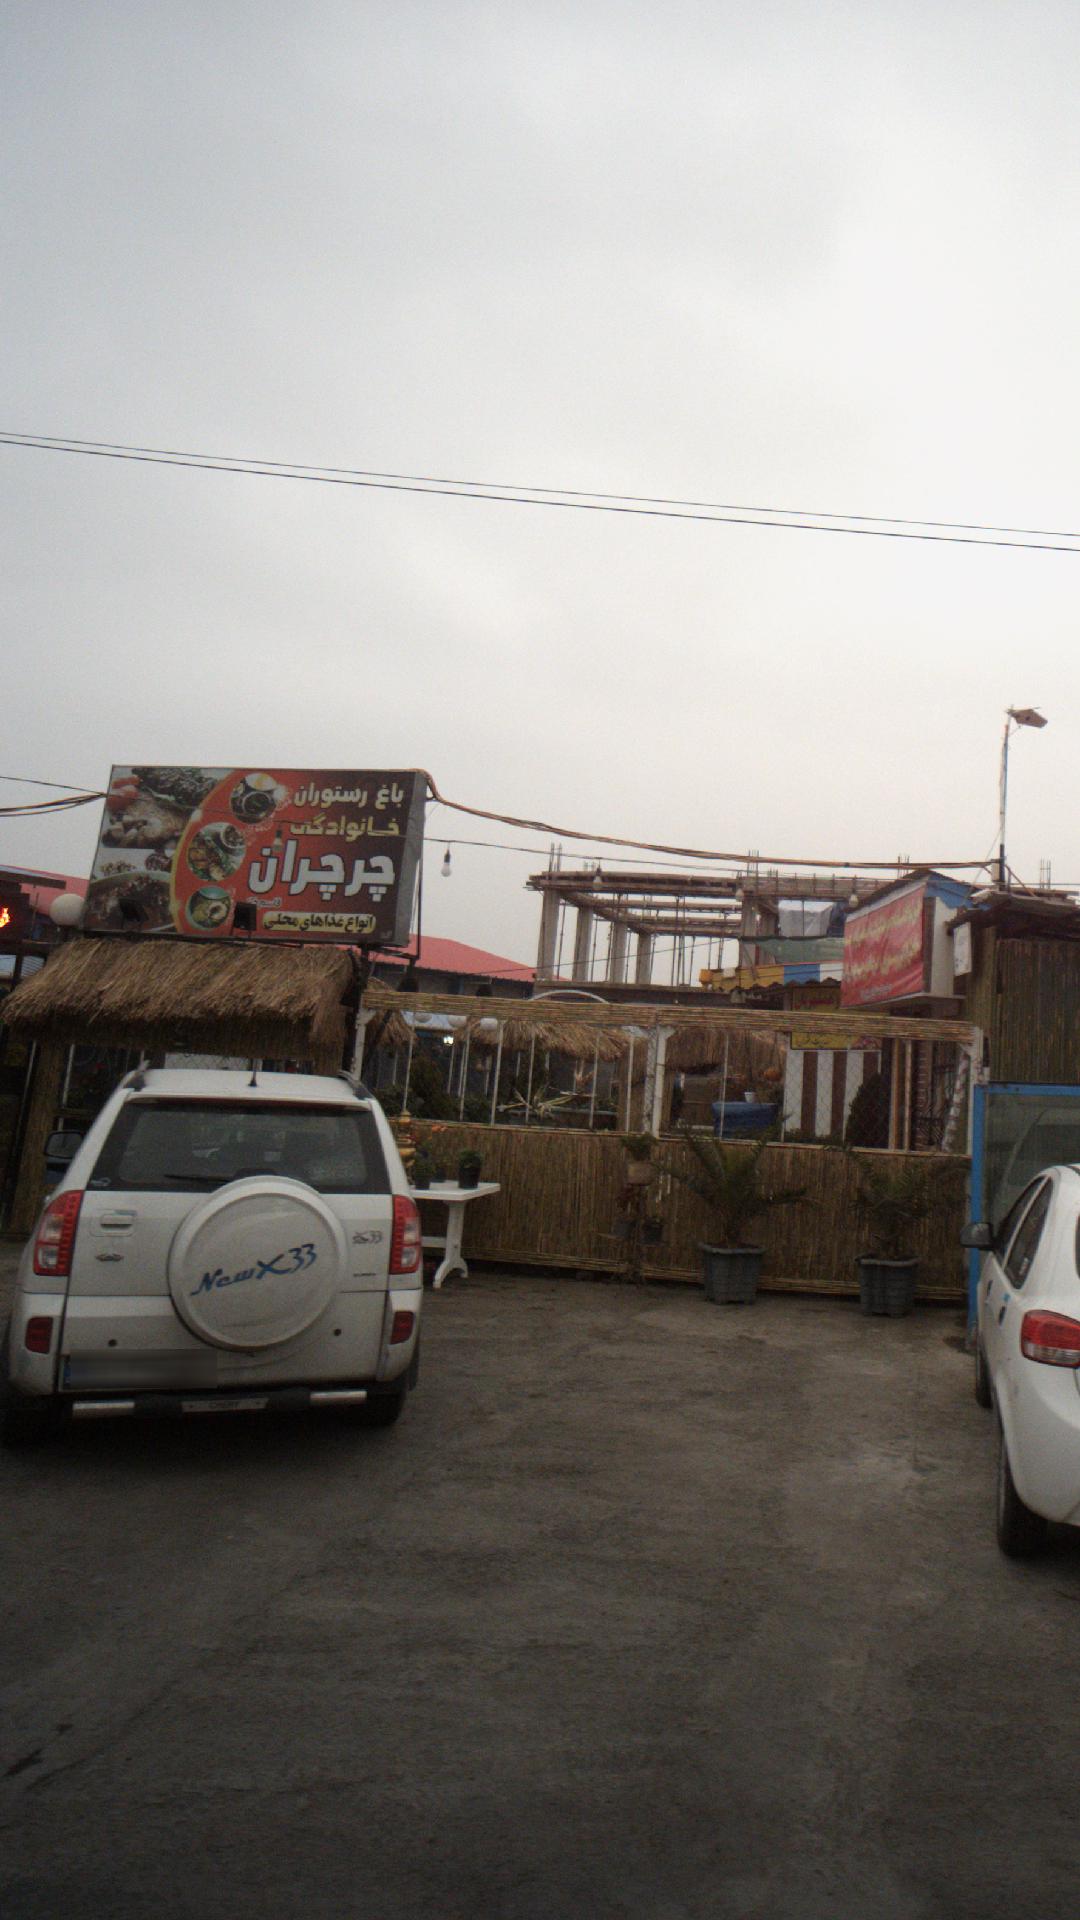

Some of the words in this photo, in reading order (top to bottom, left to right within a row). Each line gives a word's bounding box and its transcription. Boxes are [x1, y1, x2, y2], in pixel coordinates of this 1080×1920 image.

[294, 782, 368, 808] رستوران
[374, 782, 404, 810] باغ
[248, 839, 395, 902] چرچران
[263, 913, 298, 930] محلی
[299, 913, 344, 931] غذاهای
[344, 915, 374, 933] انواع
